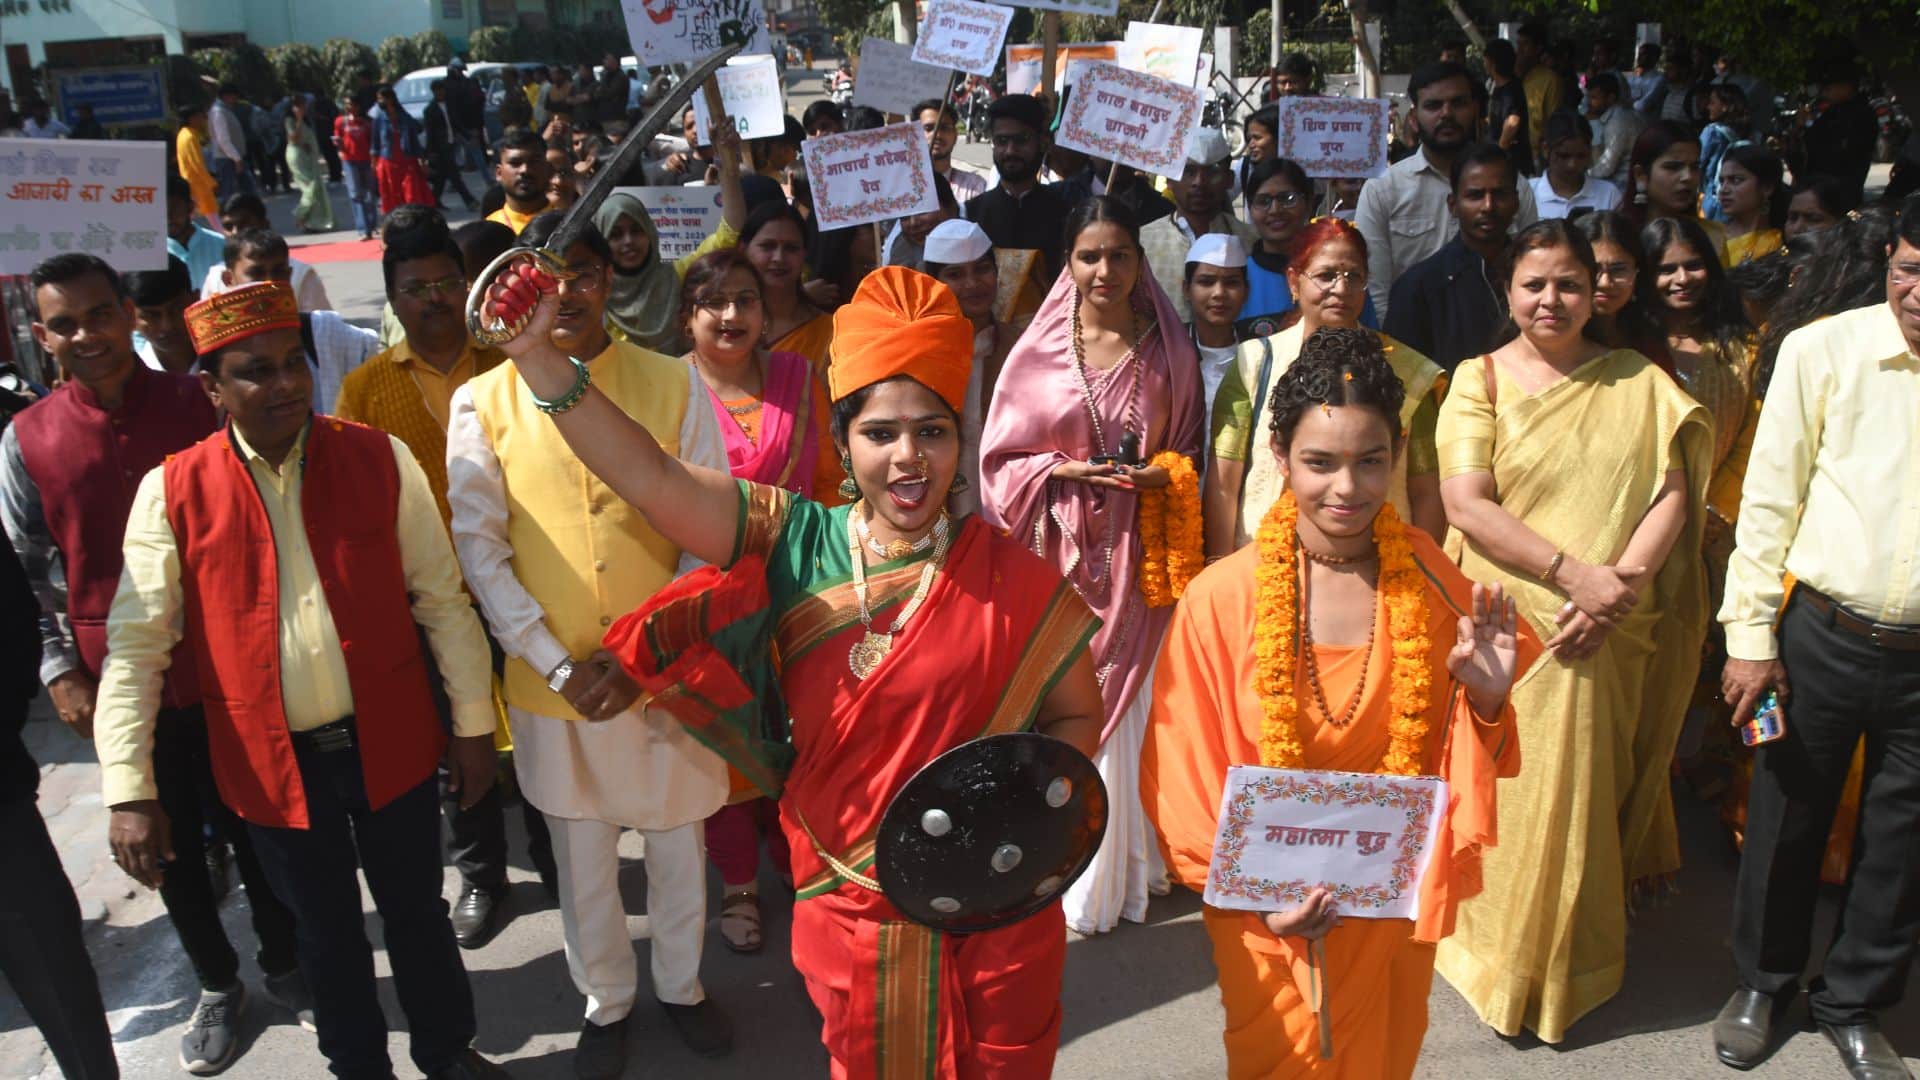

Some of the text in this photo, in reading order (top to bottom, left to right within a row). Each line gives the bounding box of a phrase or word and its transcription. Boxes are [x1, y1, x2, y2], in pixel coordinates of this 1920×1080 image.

[1096, 90, 1173, 124] लाल बहादुर
[1104, 117, 1150, 140] शास्त्री
[1302, 117, 1364, 133] शिव प्रसाद
[1319, 141, 1345, 156] गुप्त
[826, 152, 871, 176] आचार्य
[78, 183, 105, 203] का
[860, 179, 881, 194] देव
[1265, 824, 1350, 848] महात्मा
